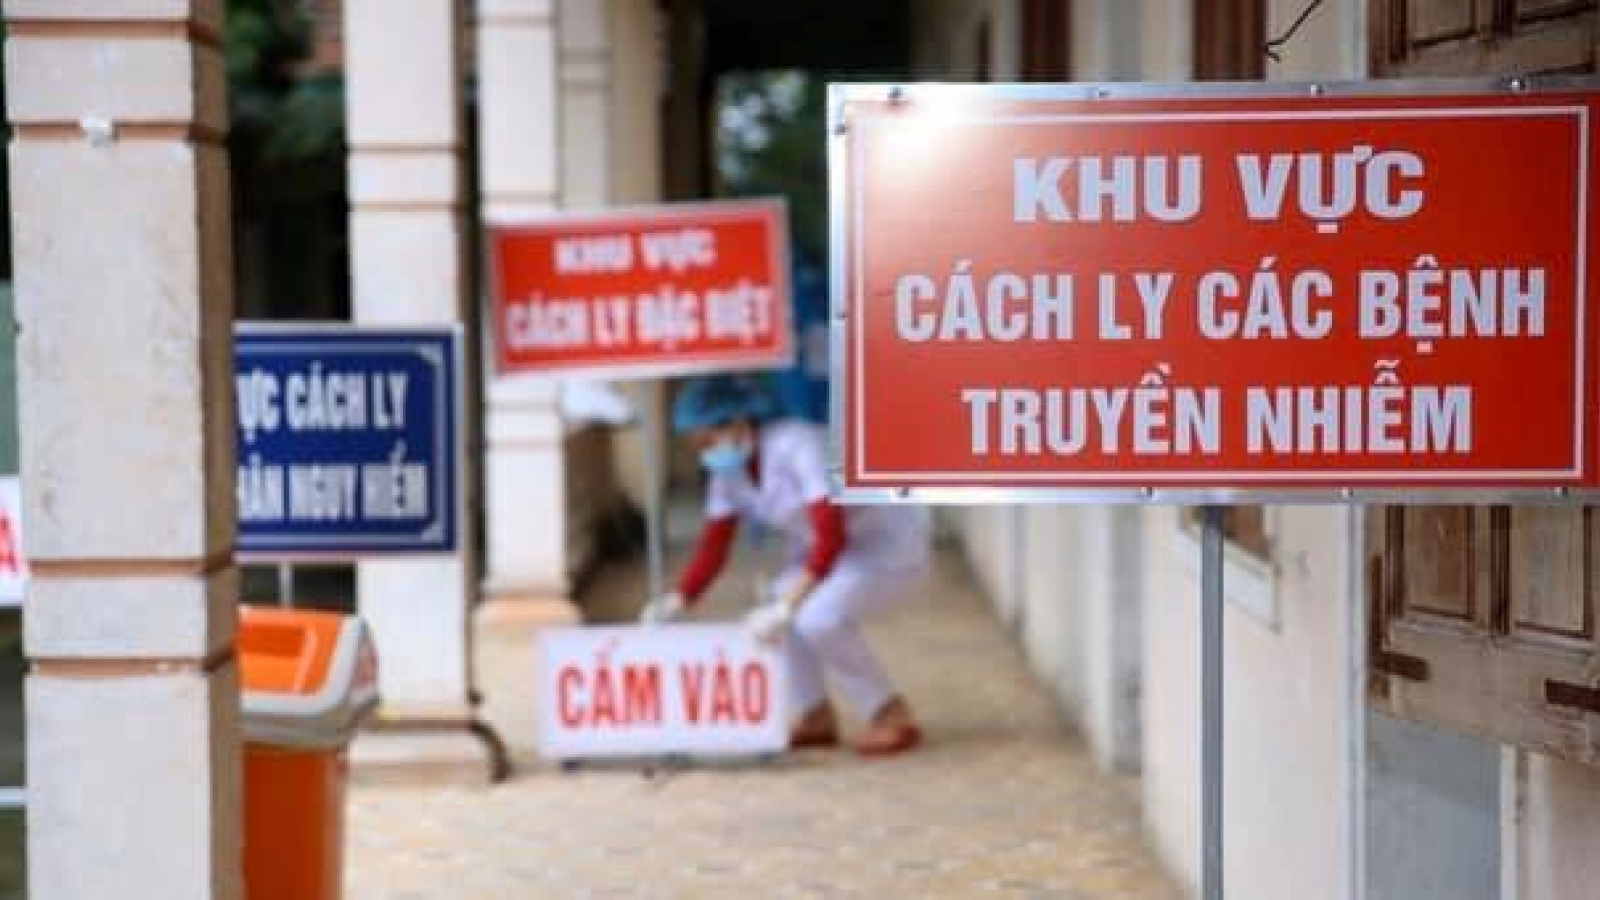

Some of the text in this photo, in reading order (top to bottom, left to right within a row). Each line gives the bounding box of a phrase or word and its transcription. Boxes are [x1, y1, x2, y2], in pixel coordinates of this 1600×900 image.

[1013, 145, 1424, 233] KHU VỰC
[895, 254, 1546, 353] CÁCH LY CÁC BỆNH
[235, 368, 280, 441] ỰC
[962, 359, 1473, 455] TRUYỀN NHIỄM
[678, 636, 769, 726] VÀO
